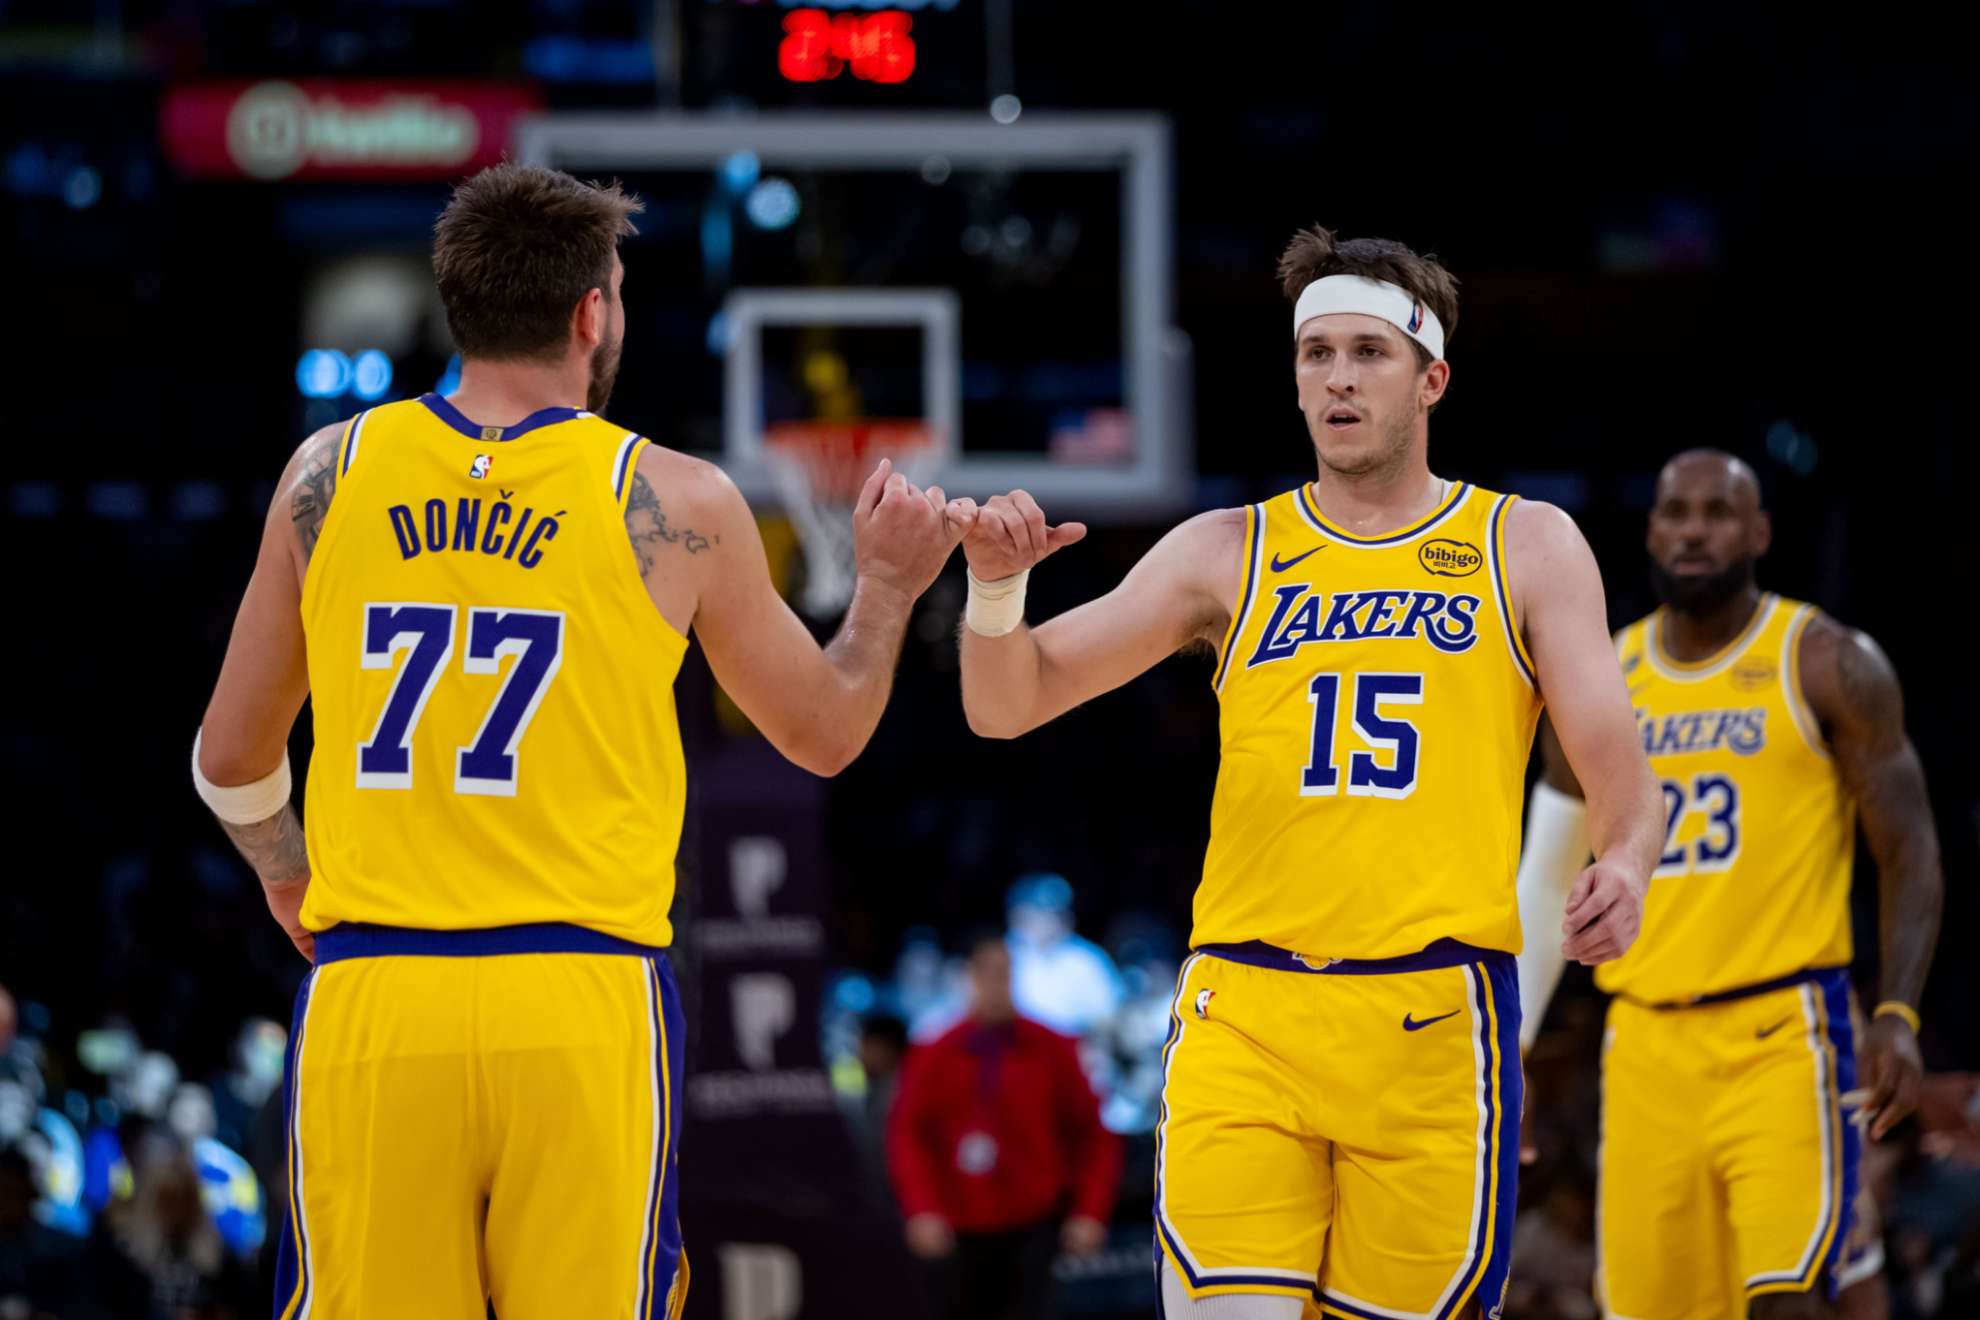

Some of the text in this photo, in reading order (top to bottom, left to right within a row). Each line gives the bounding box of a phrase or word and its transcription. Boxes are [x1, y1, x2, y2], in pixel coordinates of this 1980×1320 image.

[388, 489, 567, 569] DONČIĆ
[1425, 547, 1478, 567] bibigo
[1246, 583, 1481, 671] LAKERS
[355, 601, 565, 797] 77
[1300, 672, 1424, 800] 15
[1634, 706, 1767, 757] AKERS
[1652, 772, 1743, 880] 23
